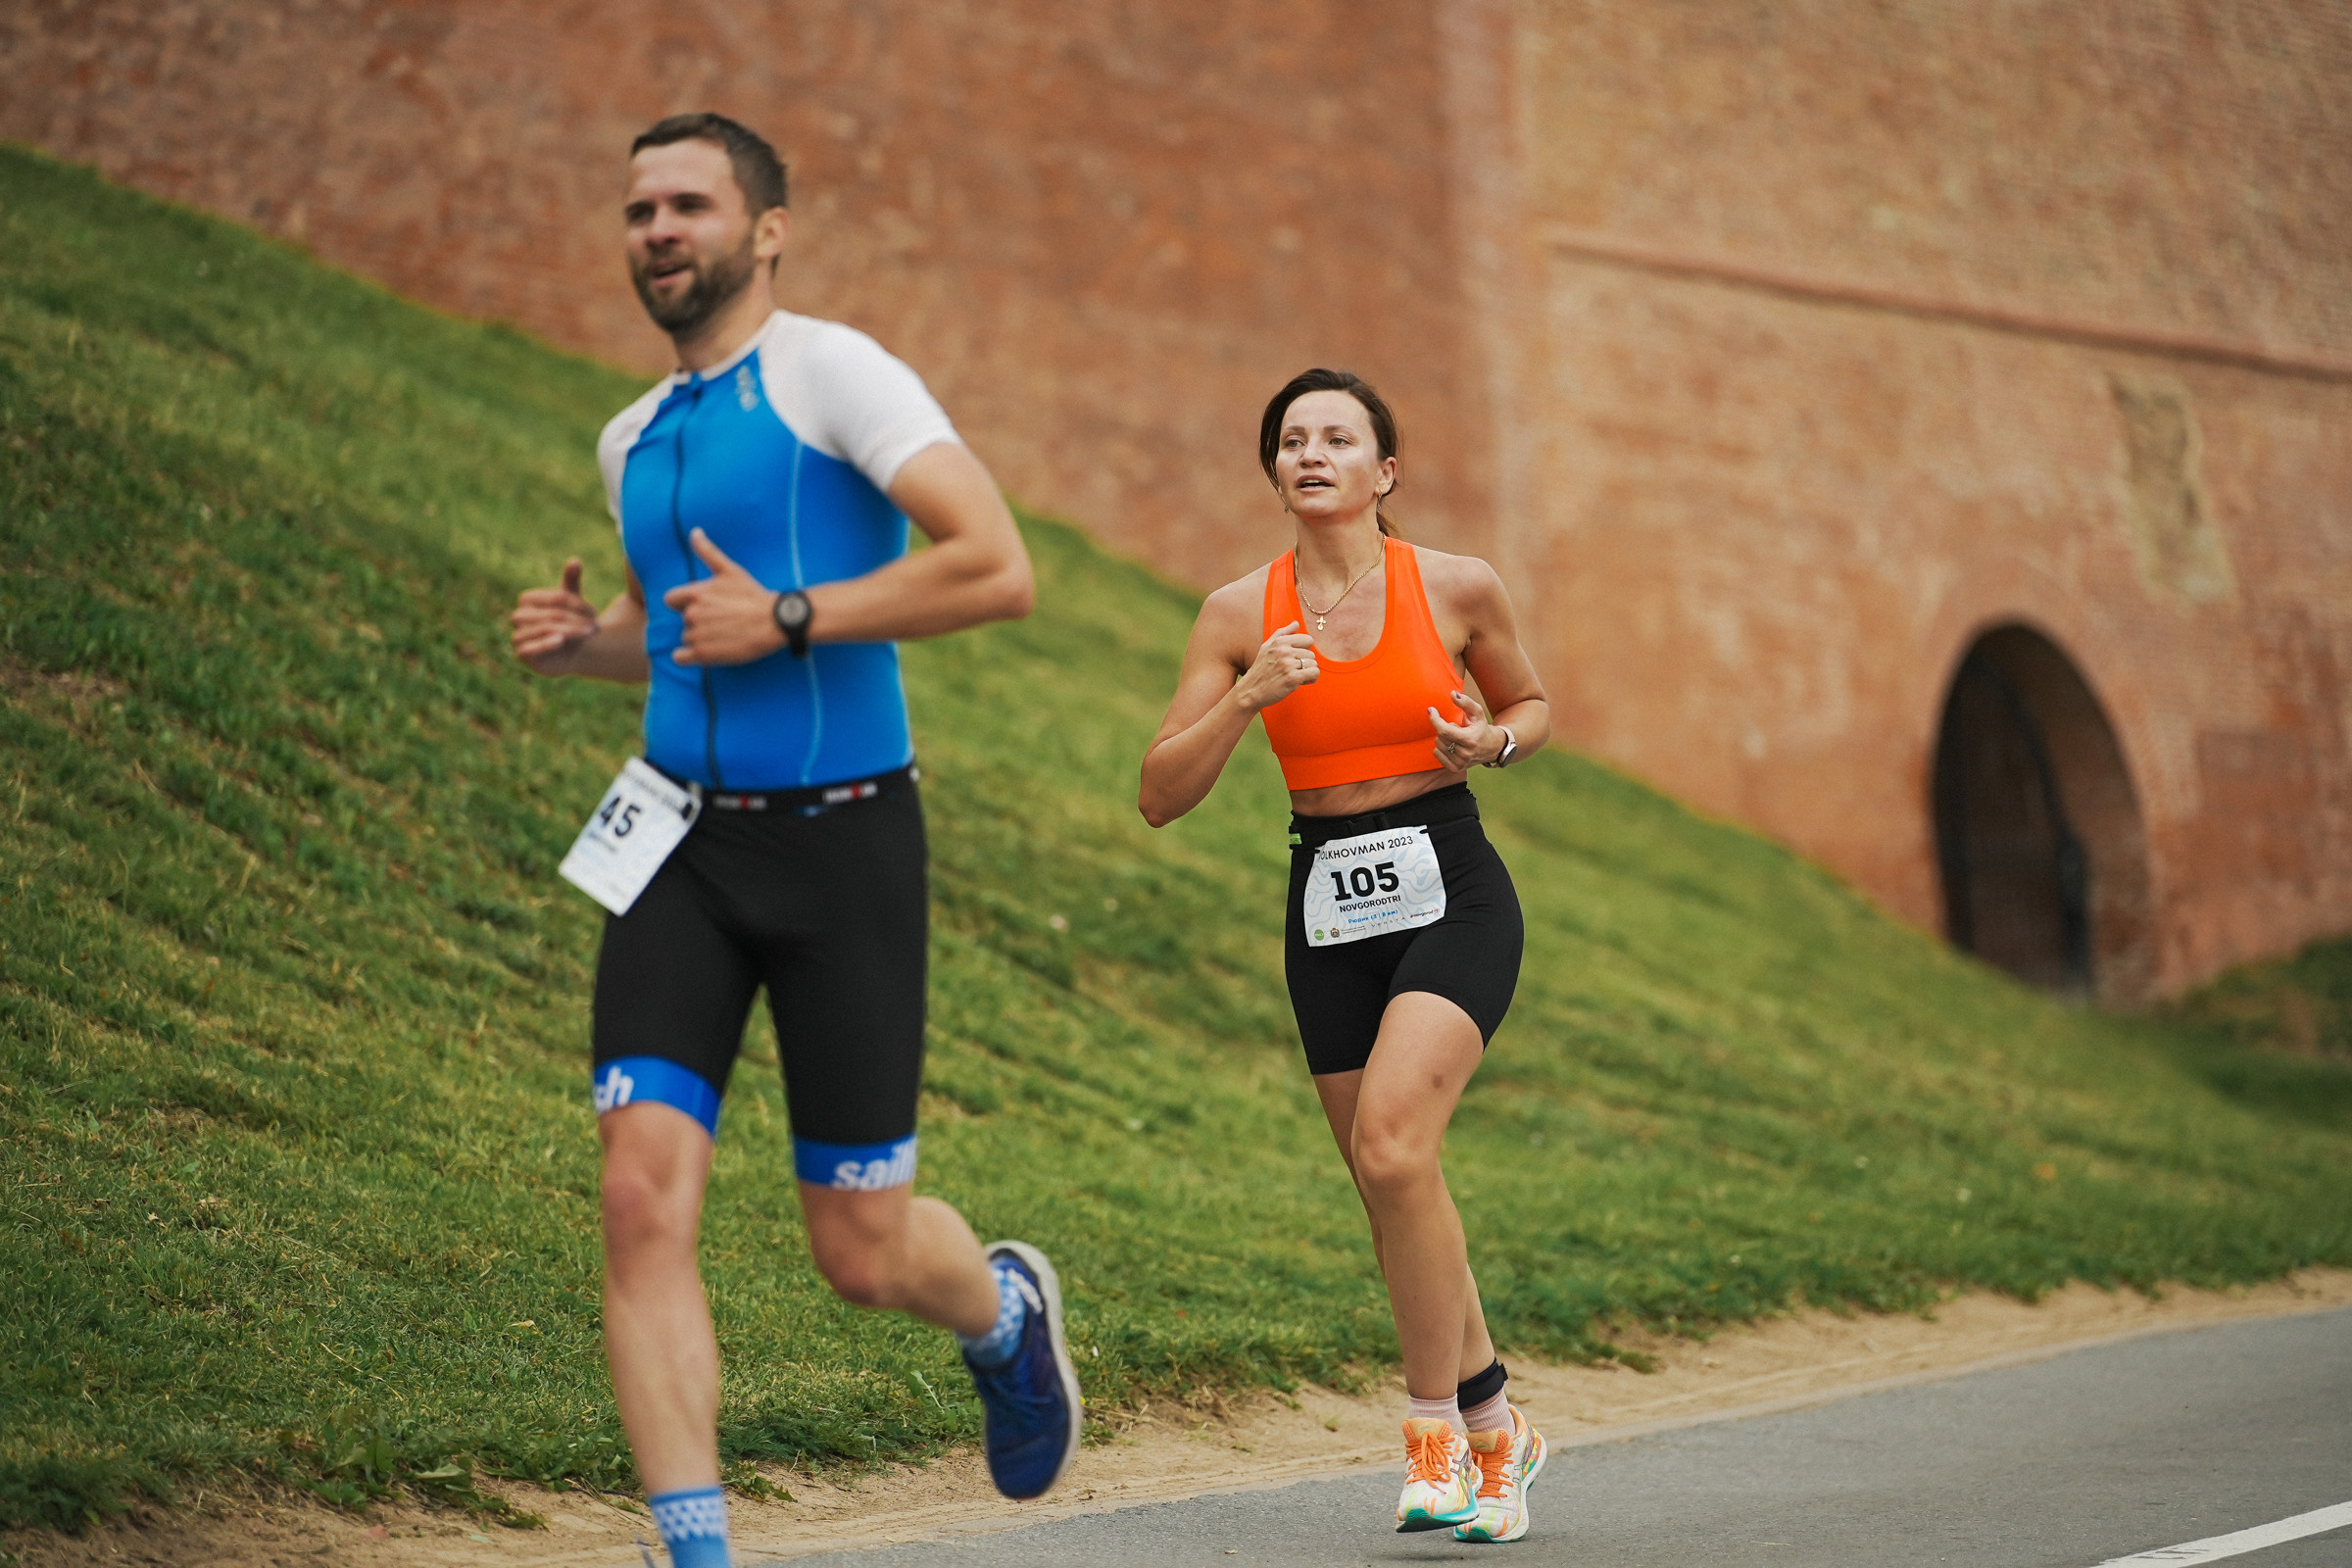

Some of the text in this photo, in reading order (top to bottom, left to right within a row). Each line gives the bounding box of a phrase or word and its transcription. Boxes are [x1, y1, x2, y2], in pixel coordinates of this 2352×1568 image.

[1388, 835, 1414, 850] 2023
[1330, 860, 1399, 902] 105
[1339, 895, 1401, 913] NOVGORODTRI
